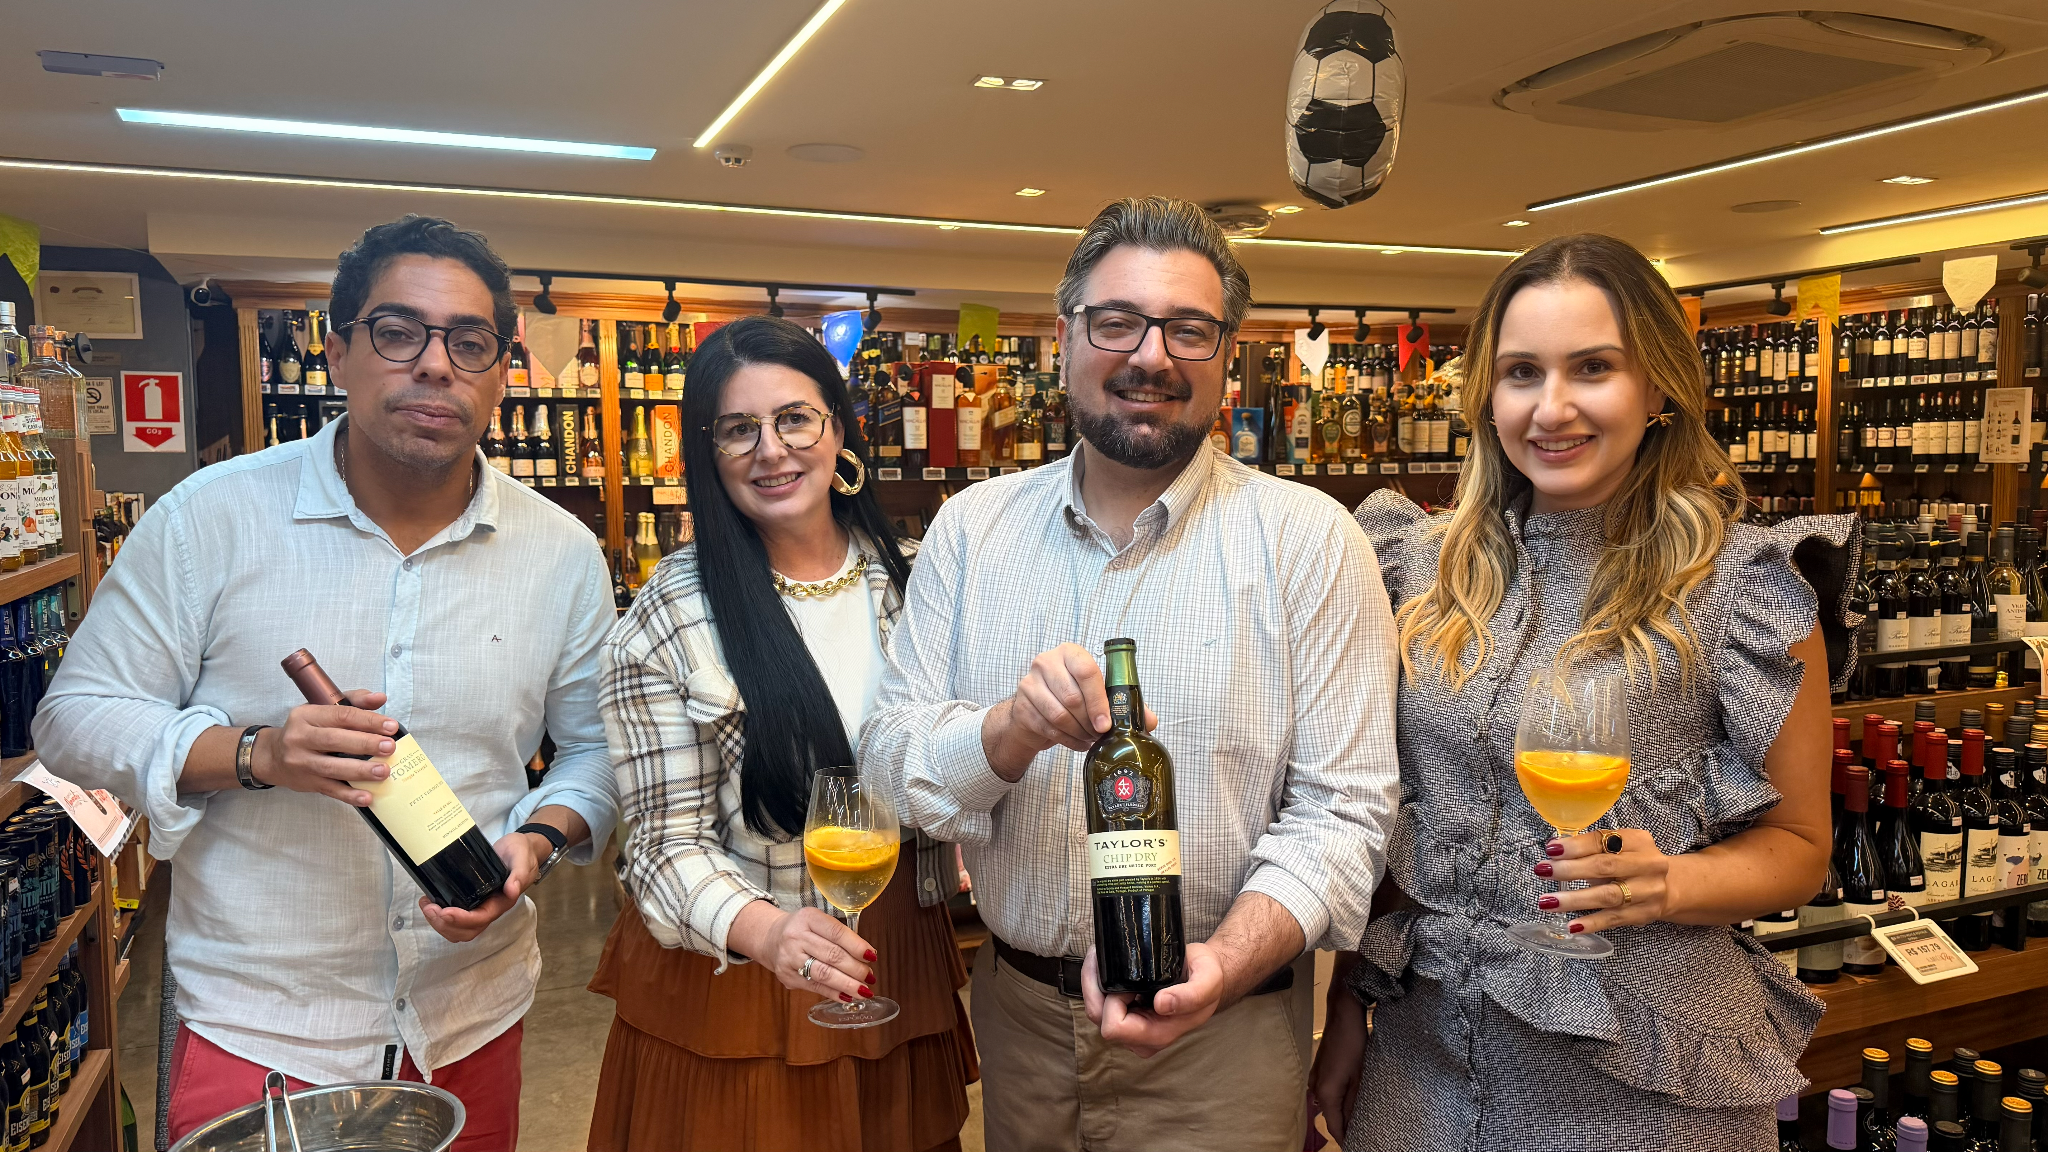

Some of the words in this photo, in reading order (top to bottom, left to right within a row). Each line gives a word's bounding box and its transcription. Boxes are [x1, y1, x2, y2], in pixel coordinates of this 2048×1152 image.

[562, 410, 577, 474] CHANDON
[662, 412, 675, 473] CHANDON
[1113, 768, 1134, 777] 1692
[1094, 838, 1166, 850] TAYLOR'S
[1103, 853, 1132, 864] CHIP
[1134, 852, 1158, 862] DRY
[1905, 946, 1919, 957] R$
